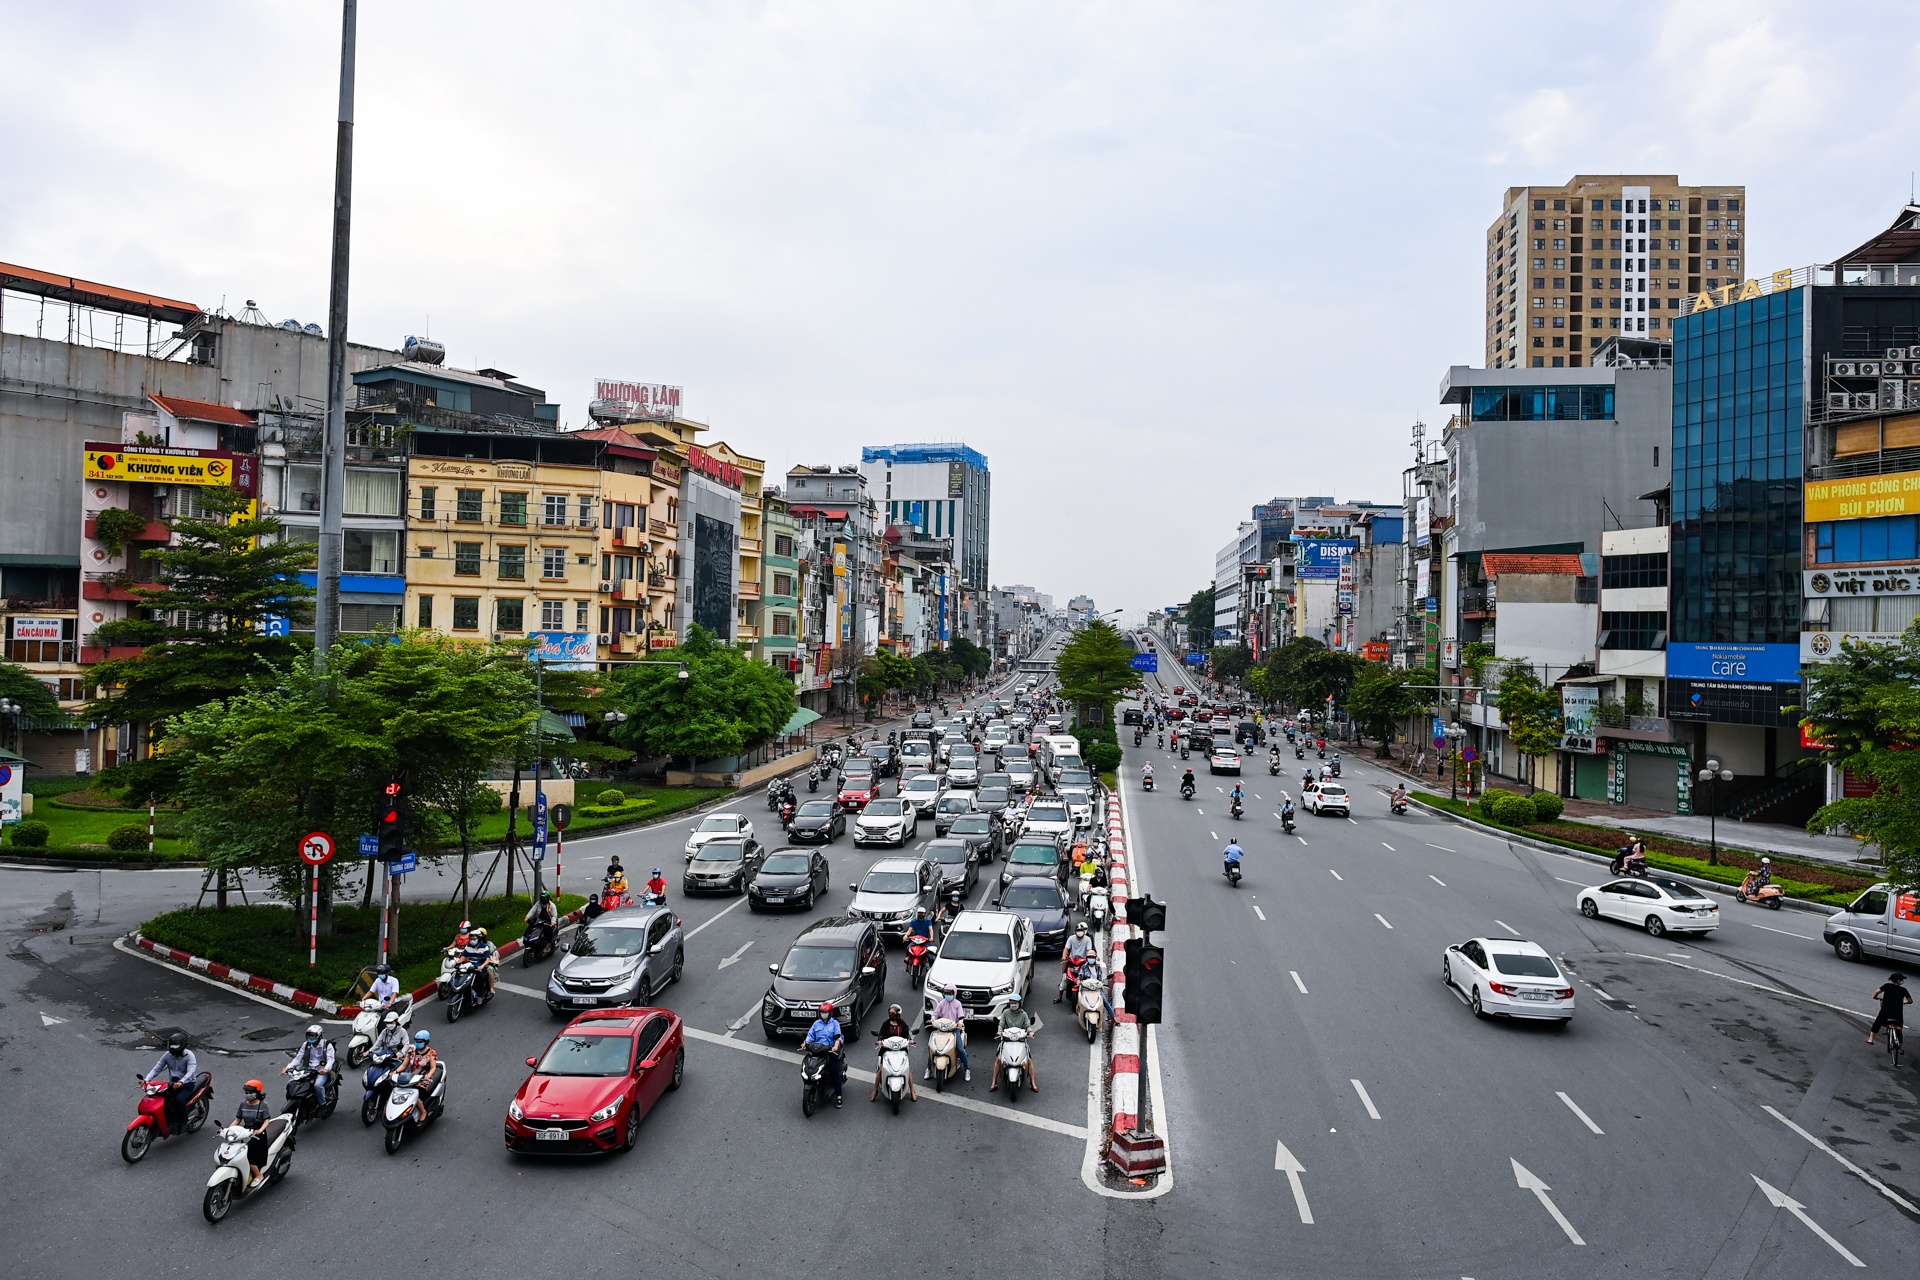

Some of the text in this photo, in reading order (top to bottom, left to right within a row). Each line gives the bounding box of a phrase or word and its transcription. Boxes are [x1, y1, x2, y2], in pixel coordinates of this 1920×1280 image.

[1692, 268, 1792, 313] ATAS
[597, 382, 648, 404] KHƯƠNG
[88, 470, 105, 479] 341
[127, 463, 204, 477] KHƯƠNG VIÊN
[1808, 484, 1829, 501] VĂN
[1831, 481, 1867, 499] PHÒNG
[1869, 478, 1900, 495] CÔNG
[1839, 497, 1905, 516] BÙI PHƠN
[1320, 546, 1354, 557] DISMY
[1834, 576, 1911, 595] VIỆT ĐỨC
[1727, 653, 1746, 661] mobile
[1712, 661, 1747, 676] care
[1703, 698, 1750, 708] vietcomindo
[361, 843, 371, 851] TÂY
